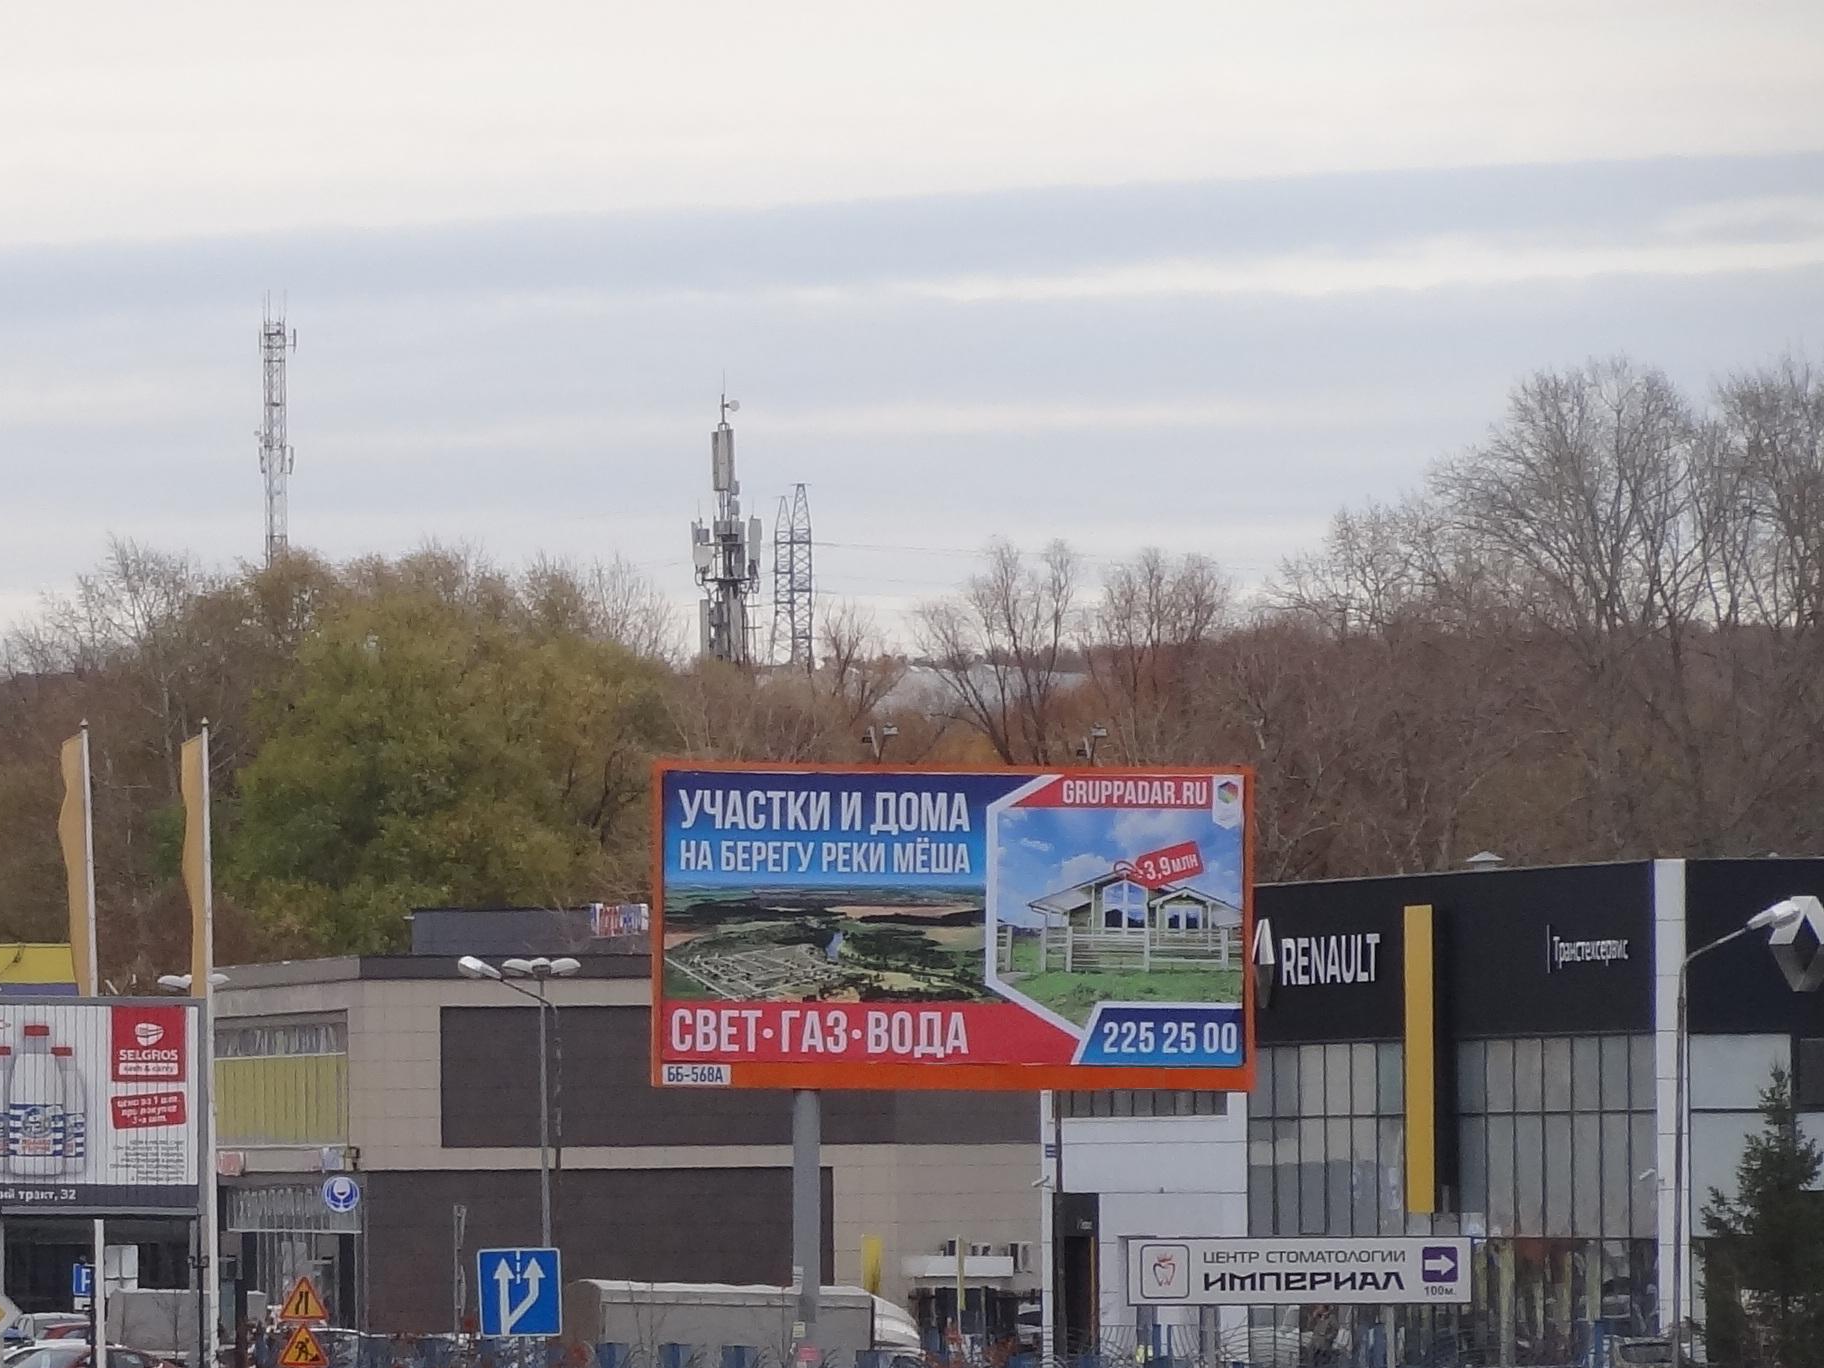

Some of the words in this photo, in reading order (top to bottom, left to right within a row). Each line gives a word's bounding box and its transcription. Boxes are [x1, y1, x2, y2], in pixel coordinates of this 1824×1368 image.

[1062, 779, 1208, 805] GRUPPADAR.RU
[678, 789, 831, 831] УЧАСТКИ
[840, 791, 862, 831] И
[869, 792, 971, 836] ДОМА
[679, 840, 713, 872] НА
[720, 841, 816, 873] БЕРЕГУ
[821, 842, 886, 874] РЕКИ
[892, 837, 971, 874] МЁША
[1281, 932, 1381, 986] RENAULT
[1103, 1021, 1155, 1054] 225
[1162, 1022, 1197, 1054] 25
[1203, 1022, 1238, 1054] 00
[119, 1049, 178, 1061] SELGROS
[60, 1189, 77, 1200] 32
[1203, 1251, 1260, 1266] ЦЕНТР
[1265, 1250, 1406, 1264] СТОМАТОЛОГИИ
[1203, 1272, 1405, 1292] ИМПЕРИАЛ
